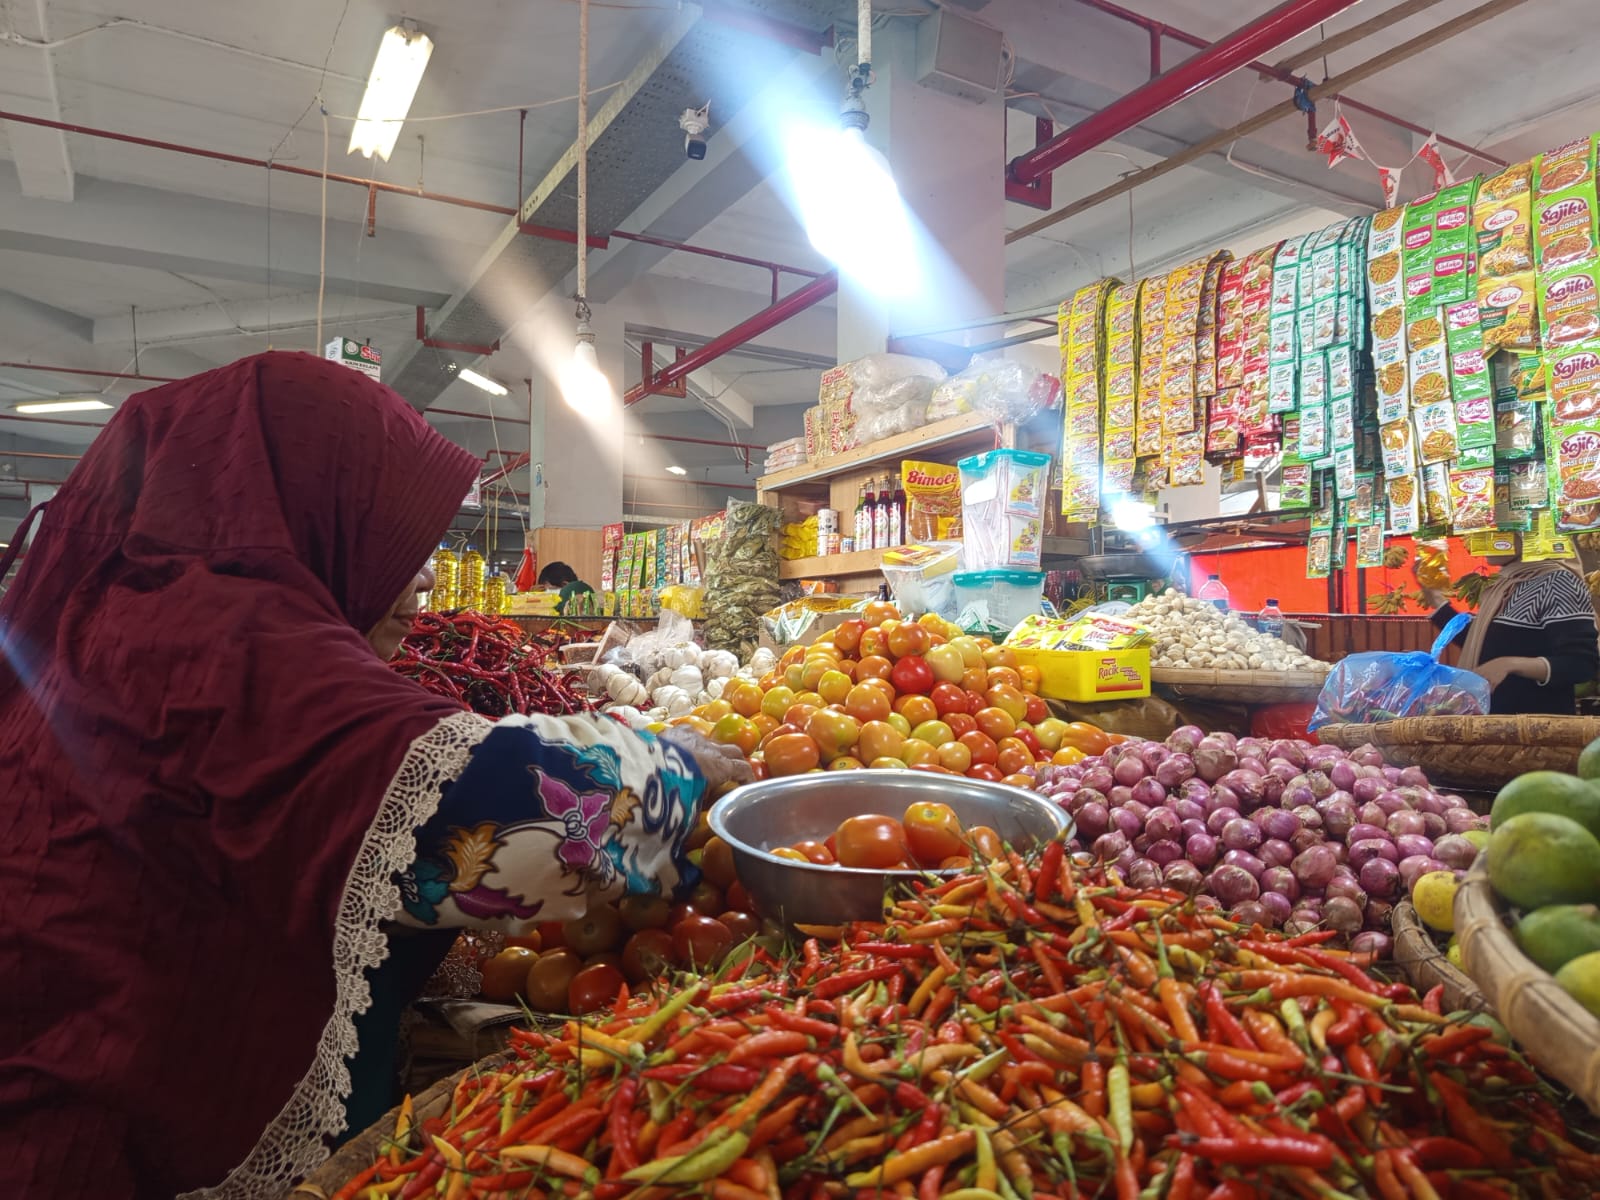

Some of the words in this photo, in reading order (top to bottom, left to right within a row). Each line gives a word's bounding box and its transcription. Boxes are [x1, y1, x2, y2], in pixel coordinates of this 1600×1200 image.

[1540, 202, 1588, 226] Sajiku
[1545, 279, 1594, 302] Sajiku
[1552, 356, 1600, 379] Sajiku
[906, 470, 957, 486] Bimoli
